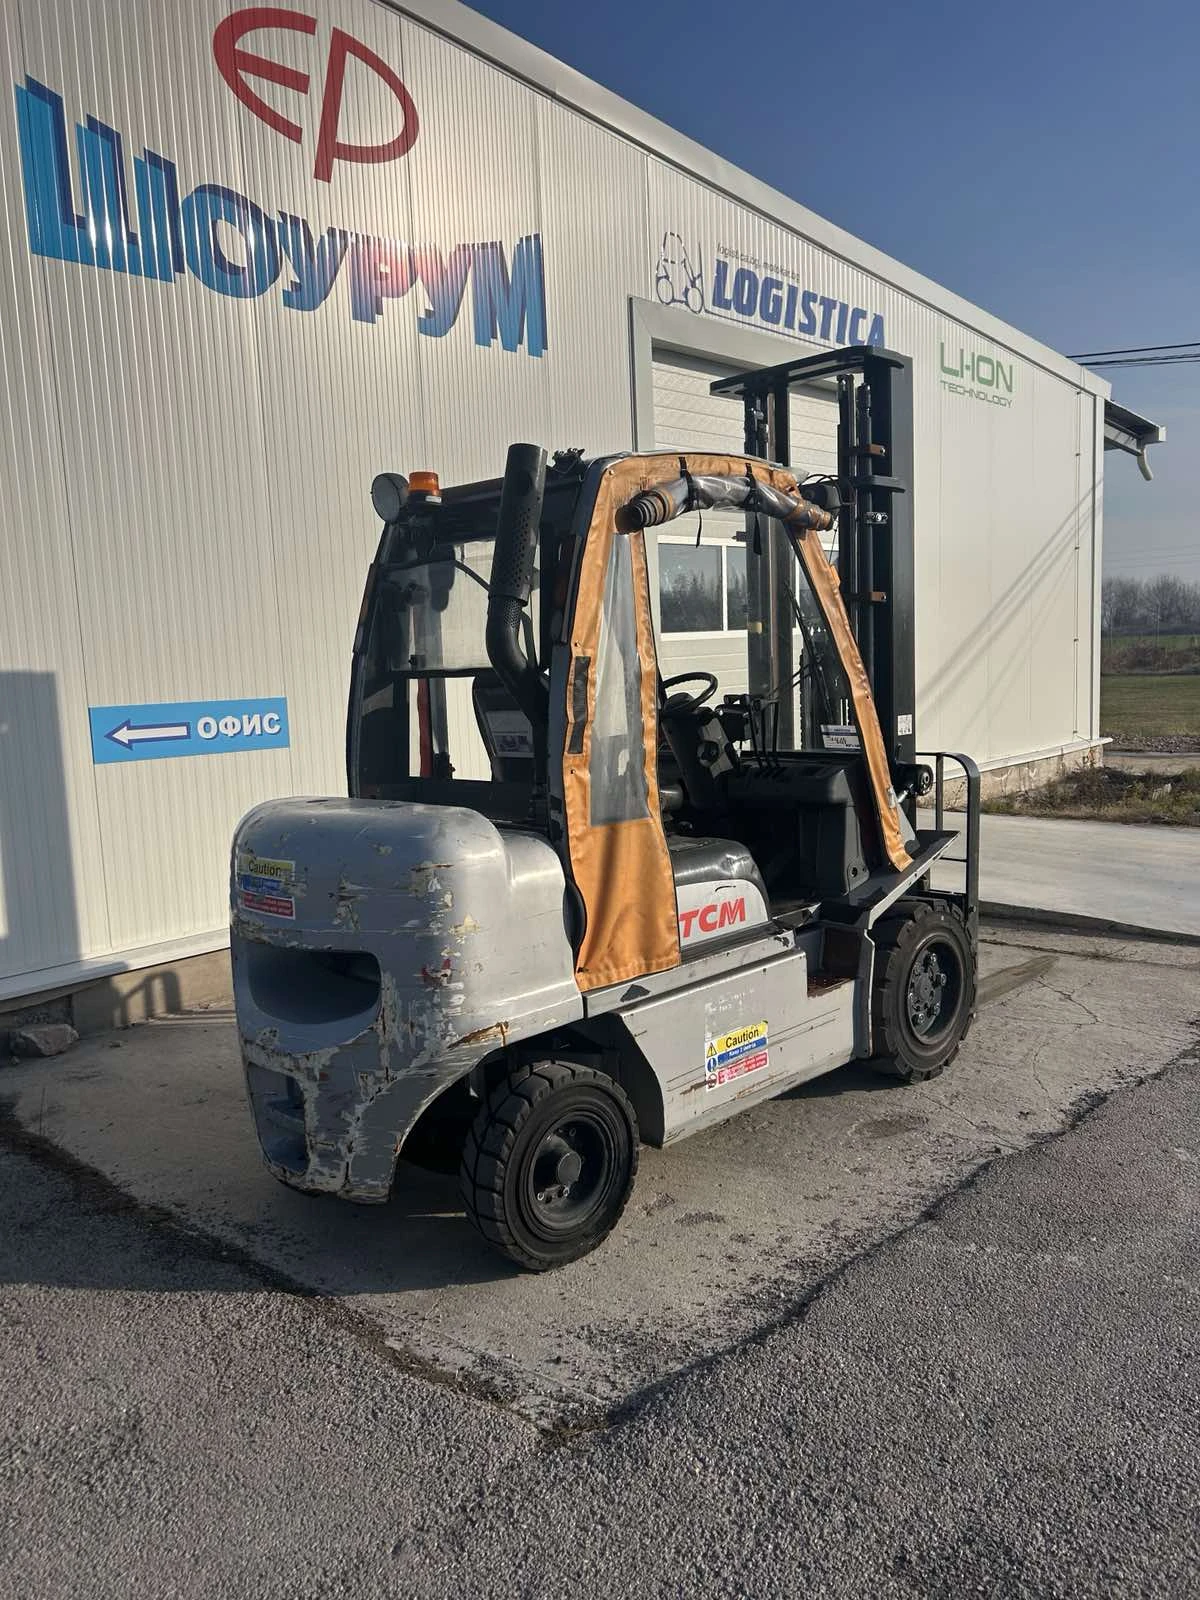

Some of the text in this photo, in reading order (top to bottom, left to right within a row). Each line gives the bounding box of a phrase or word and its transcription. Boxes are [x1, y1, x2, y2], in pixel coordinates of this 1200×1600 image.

[712, 258, 885, 349] LOGISTICA
[940, 379, 1013, 408] TECHNOLOGY
[196, 712, 281, 740] ОФИС
[248, 860, 282, 877] Caution
[679, 897, 746, 938] TCM
[725, 1026, 759, 1048] Caution
